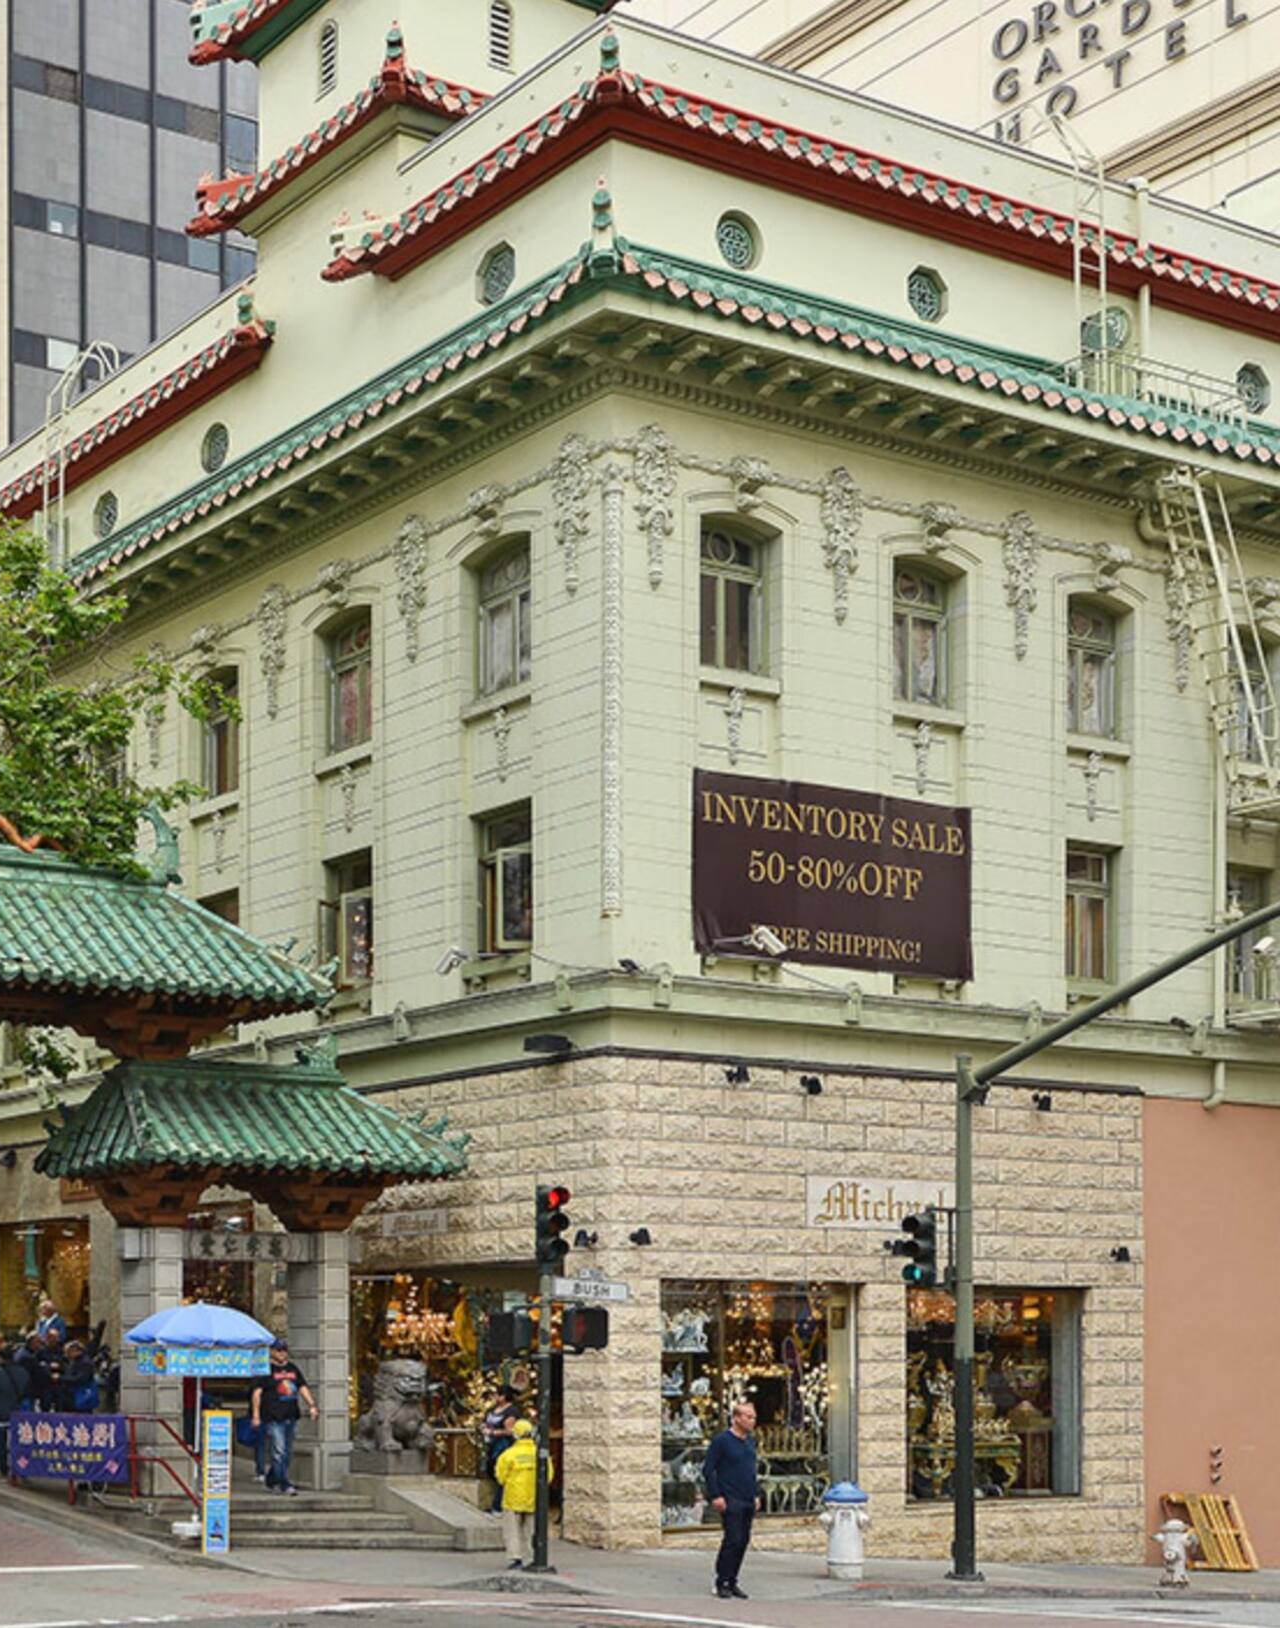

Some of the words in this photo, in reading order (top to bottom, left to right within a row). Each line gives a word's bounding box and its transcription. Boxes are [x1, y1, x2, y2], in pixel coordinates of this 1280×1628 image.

[701, 791, 884, 844] INVENTORY
[892, 818, 965, 856] SALE
[748, 849, 923, 901] 50-80%OFF
[815, 929, 922, 963] SHIPPING!
[814, 1181, 945, 1224] Michl
[574, 1283, 610, 1297] BUSH
